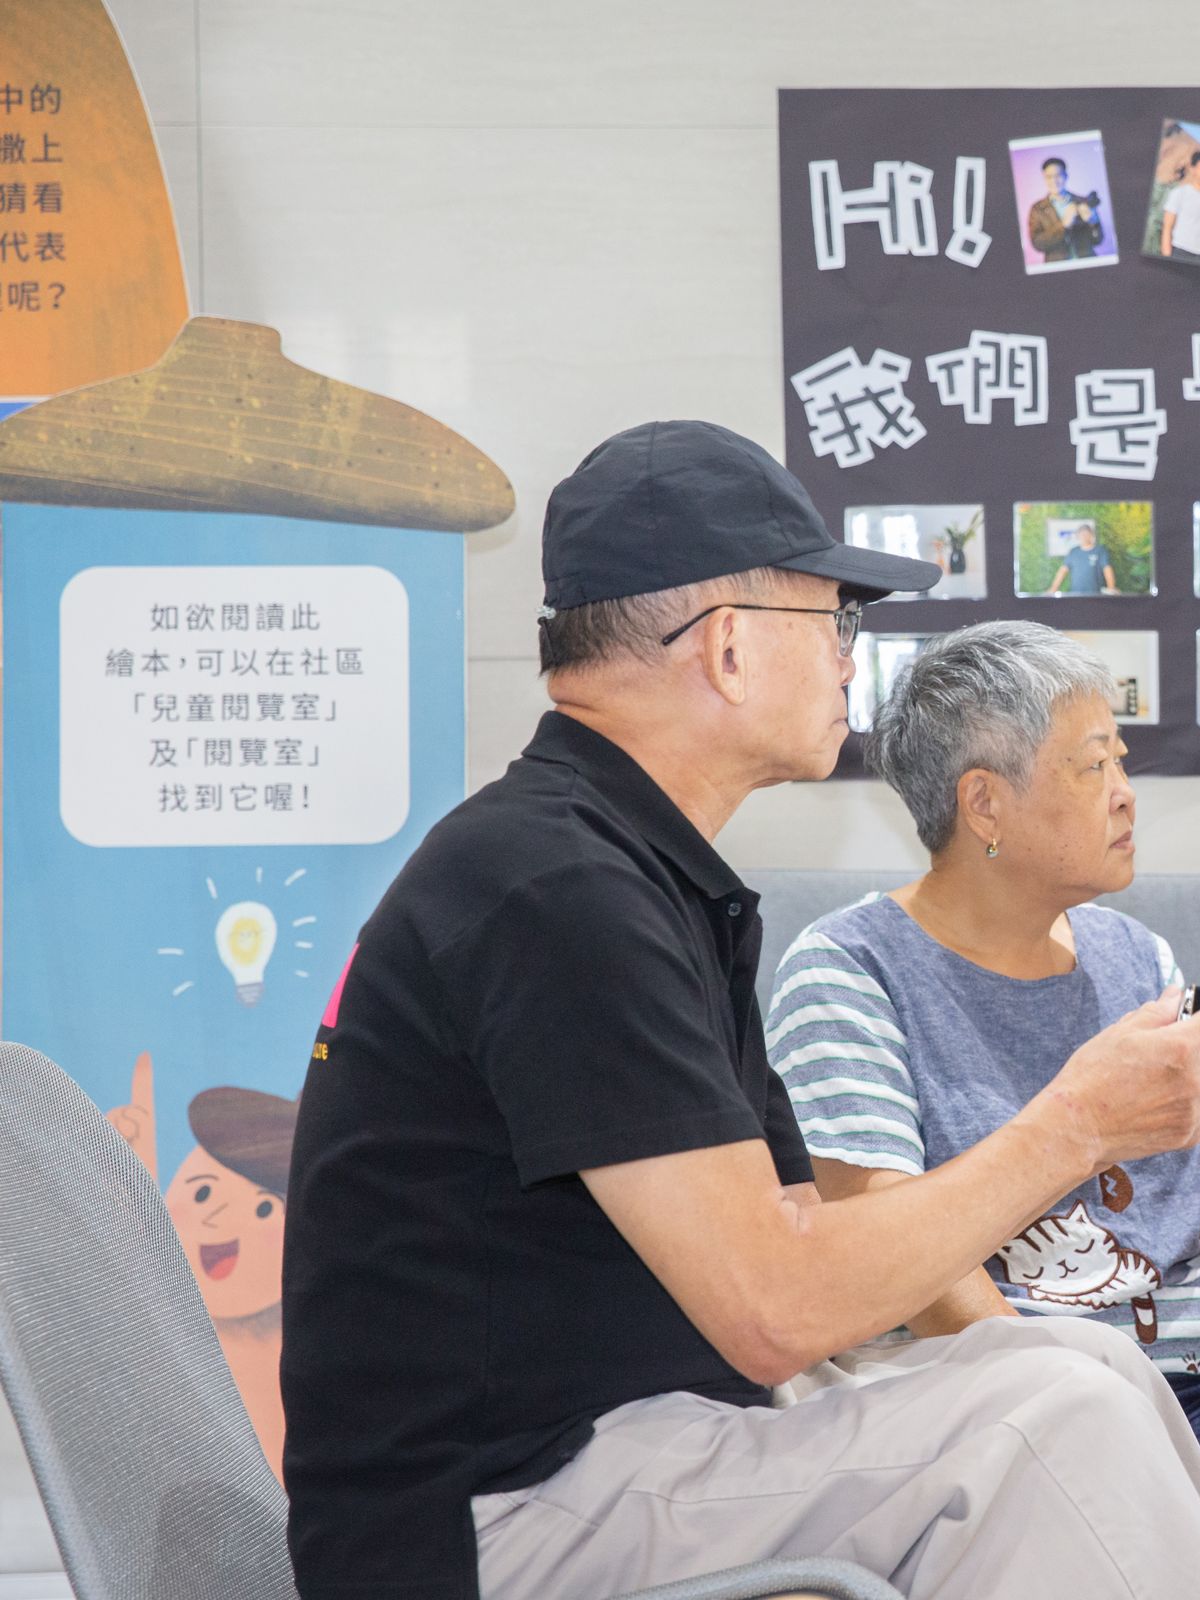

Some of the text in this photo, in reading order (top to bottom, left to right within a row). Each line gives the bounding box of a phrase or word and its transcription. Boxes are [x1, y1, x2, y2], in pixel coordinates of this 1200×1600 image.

[0, 83, 62, 115] 中的
[808, 155, 992, 271] Hi!
[0, 231, 67, 263] 代表
[150, 602, 321, 633] 如欲閱讀此
[133, 692, 339, 724] 「兒童閱覽室」
[149, 737, 321, 769] 及「閱覽室」
